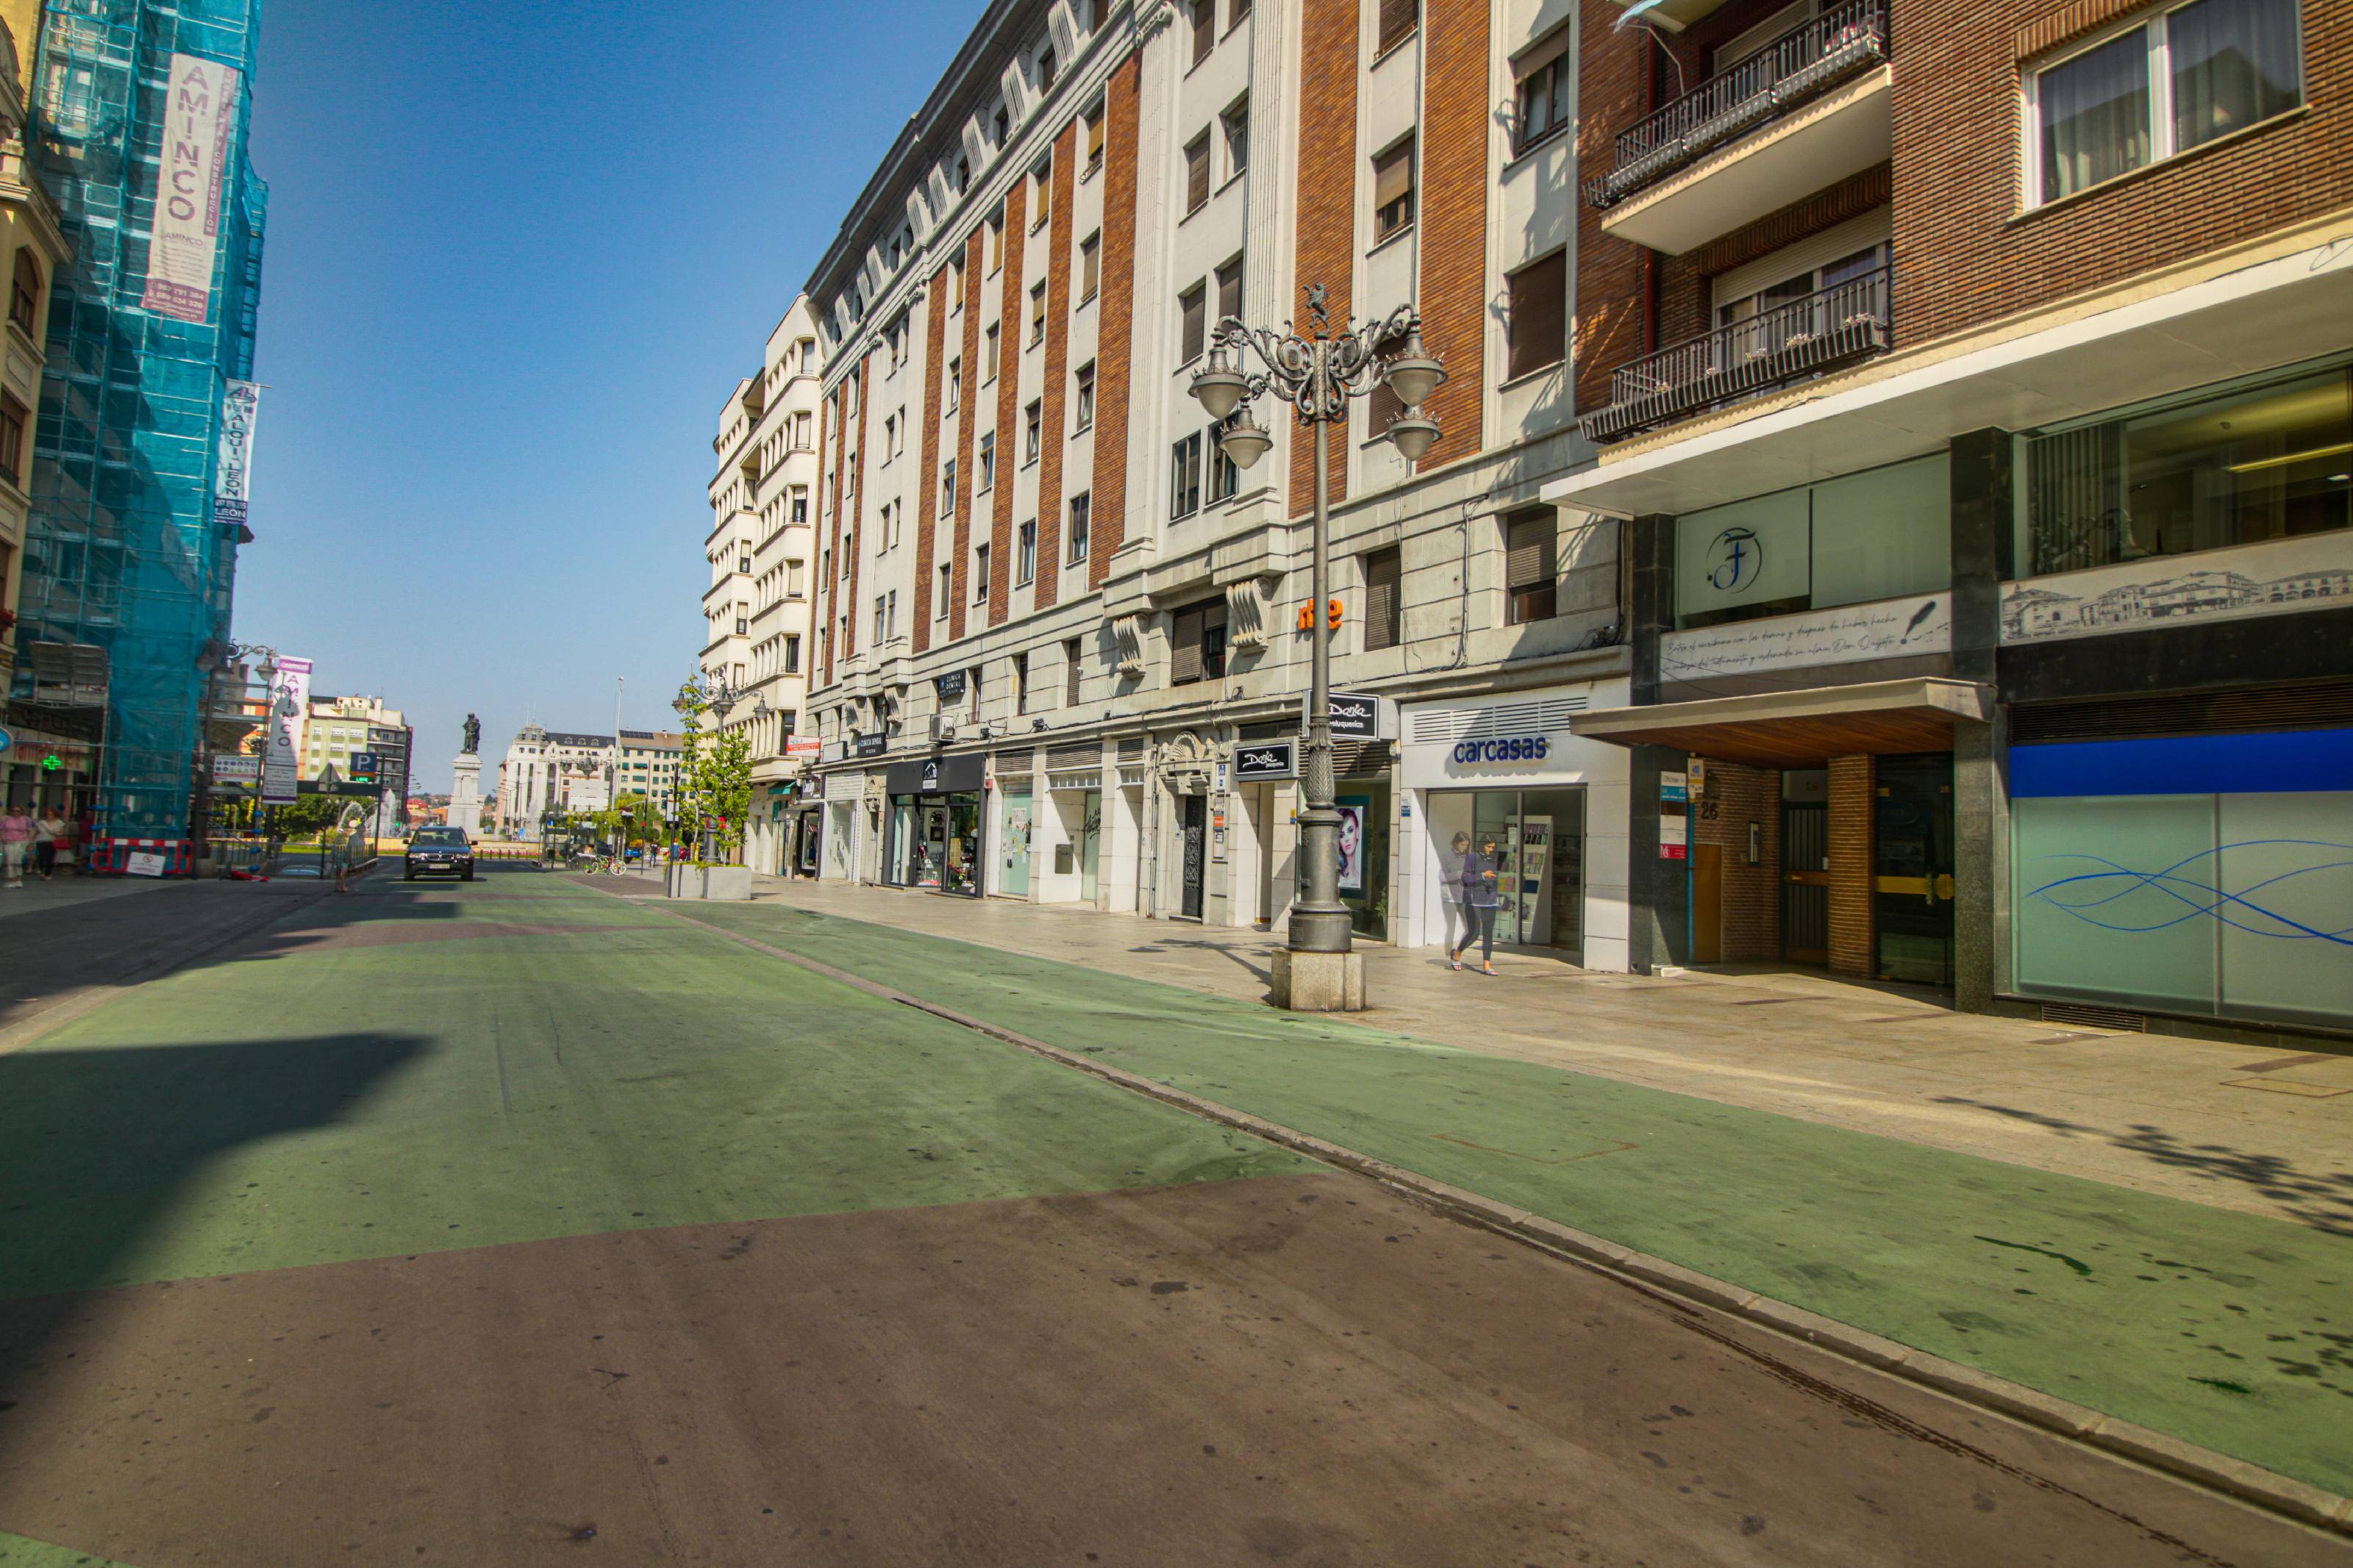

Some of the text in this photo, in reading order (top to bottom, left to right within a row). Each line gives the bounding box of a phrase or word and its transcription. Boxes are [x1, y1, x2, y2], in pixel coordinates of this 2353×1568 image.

[168, 65, 210, 221] AMINCO
[164, 232, 204, 246] AMINCO
[1298, 599, 1343, 630] rte
[1832, 637, 1855, 654] Don
[1454, 737, 1546, 764] carcasas
[357, 754, 371, 770] P
[1243, 751, 1278, 769] Dania
[1701, 801, 1718, 820] 26
